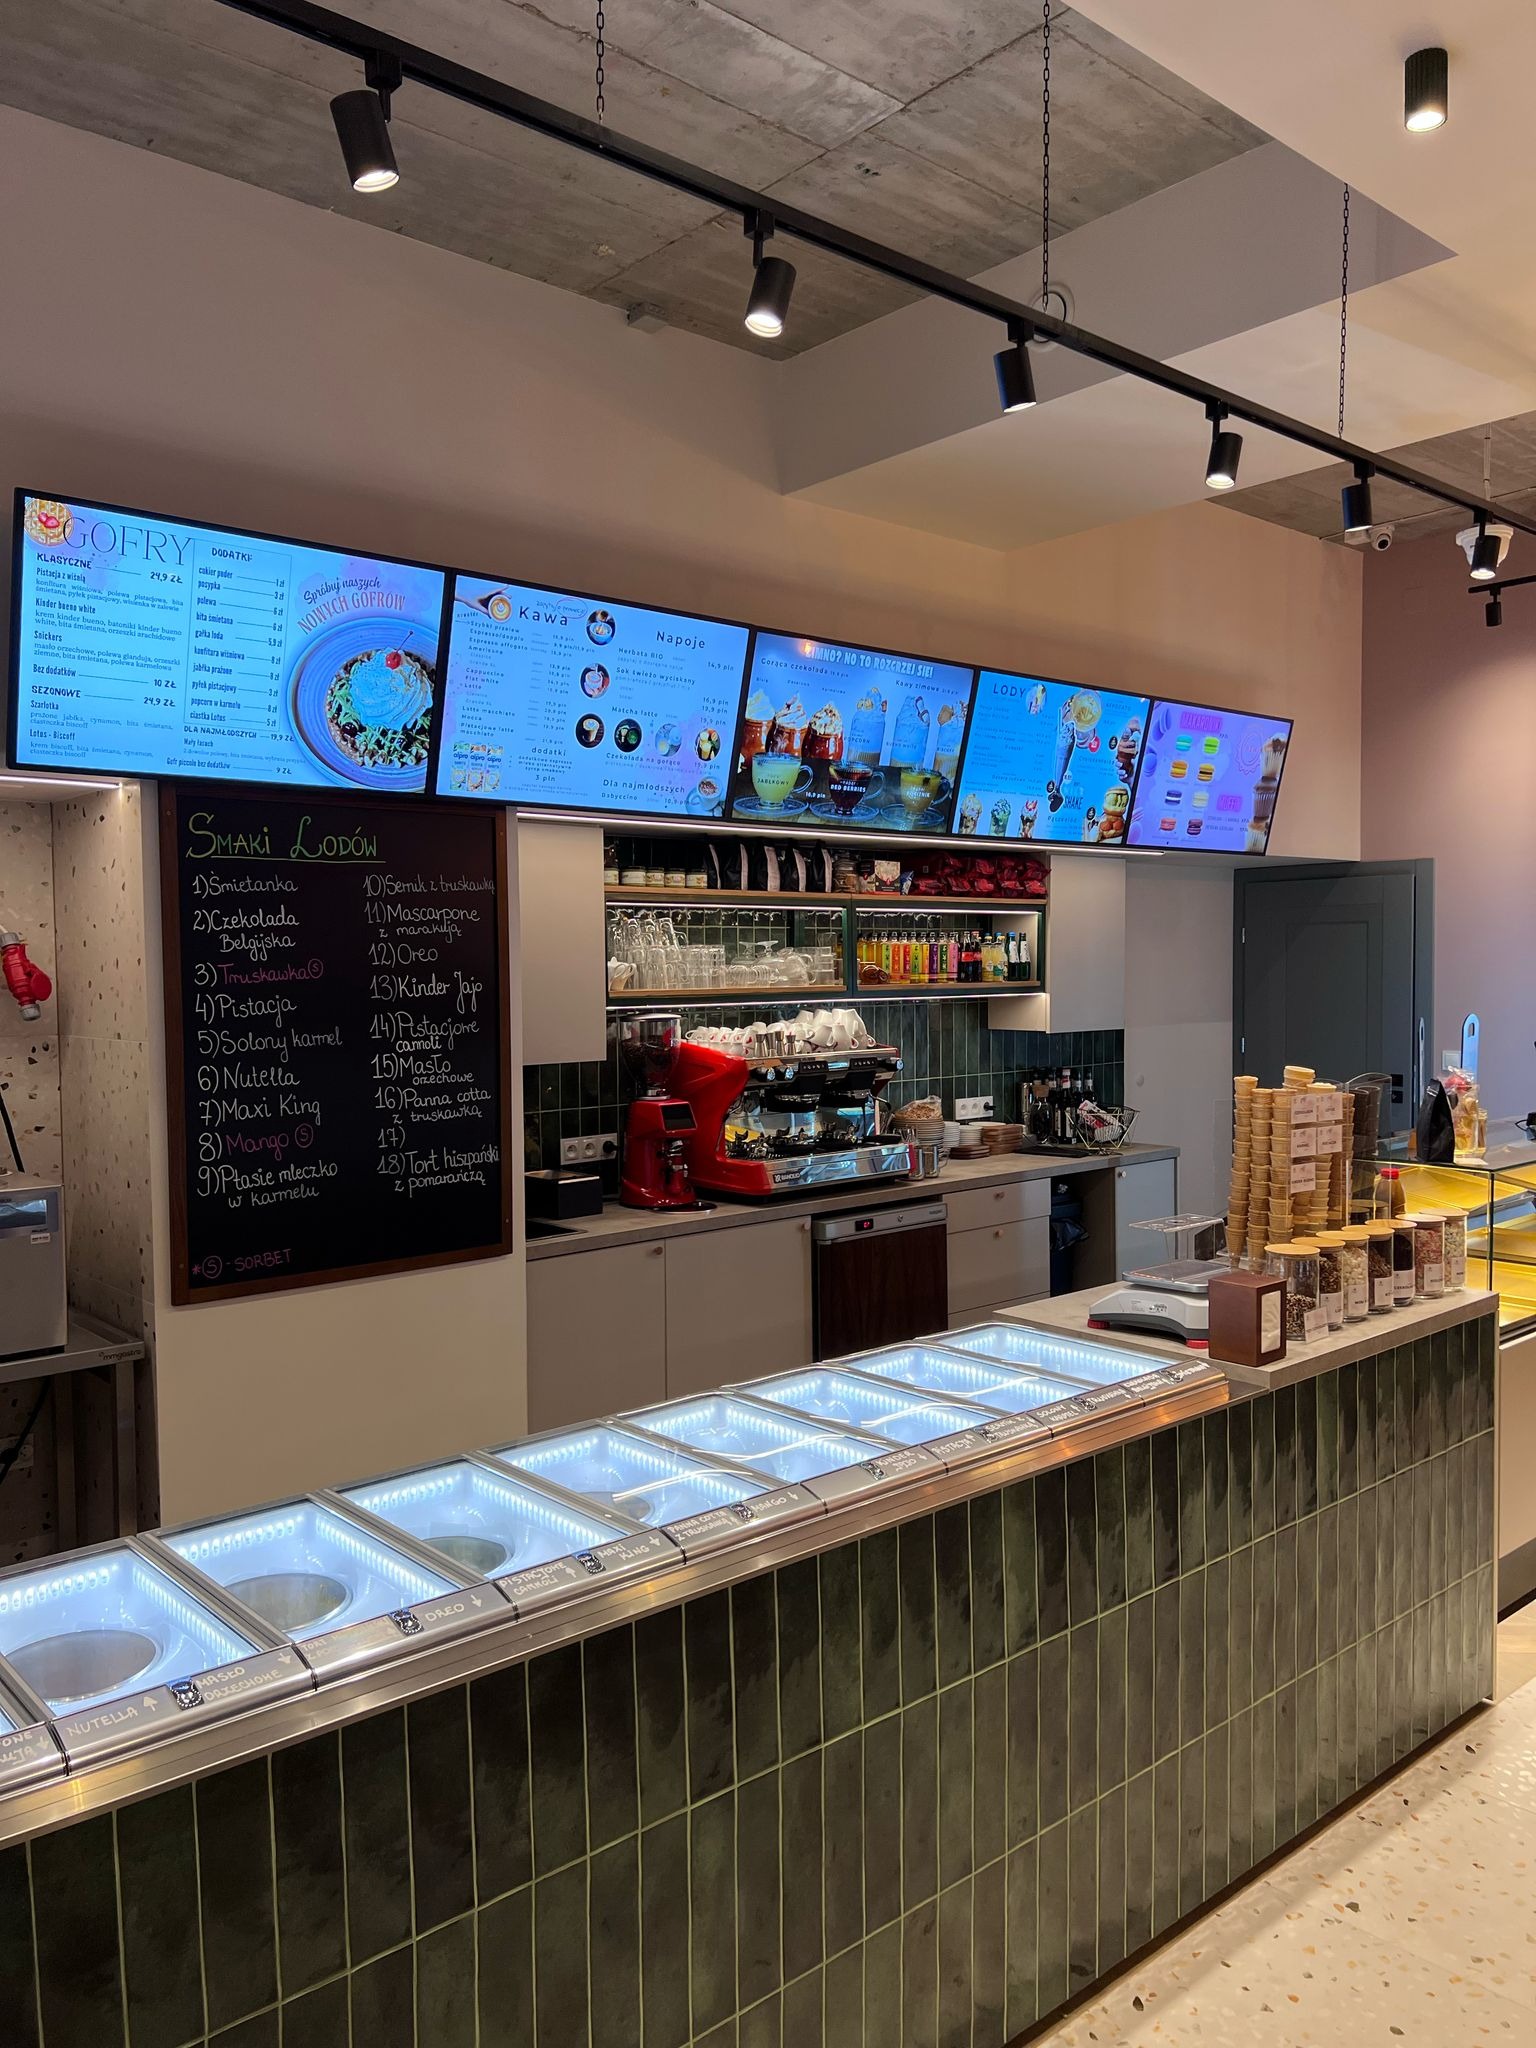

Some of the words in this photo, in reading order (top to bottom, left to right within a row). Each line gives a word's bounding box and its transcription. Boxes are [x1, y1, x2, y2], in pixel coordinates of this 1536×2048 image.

[63, 517, 191, 566] GOFRY
[37, 552, 93, 570] KLASYCZNE
[212, 548, 252, 562] DODATKI:
[37, 567, 61, 580] Pistacja
[151, 571, 169, 584] 24,9
[170, 573, 183, 584] ZŁ
[198, 566, 216, 576] cukier
[217, 570, 232, 579] puder
[198, 580, 221, 591] posypka
[303, 577, 340, 605] Spróbuj
[342, 577, 381, 592] naszych
[36, 598, 57, 609] Kinder
[58, 601, 78, 612] bueno
[79, 604, 96, 615] white
[197, 596, 216, 606] polewa
[297, 595, 349, 635] NOWYCH
[519, 606, 568, 626] Kawa
[34, 630, 63, 642] Snickers
[656, 630, 705, 649] Napoje
[618, 647, 648, 658] Herbata
[650, 651, 664, 661] BIO
[844, 652, 857, 666] NO
[859, 654, 872, 668] TO
[33, 663, 45, 673] Bez
[616, 667, 629, 675] Sok
[31, 685, 81, 698] SEZONOWE
[154, 679, 162, 687] 10
[164, 680, 176, 688] ZŁ
[993, 683, 1027, 698] LODY
[30, 700, 59, 710] Szarlotka
[144, 697, 161, 707] 24,9
[163, 698, 176, 707] ZŁ
[612, 705, 638, 716] Matcha
[30, 729, 47, 739] Lotus
[53, 730, 75, 741] Biscoff
[184, 725, 198, 734] DLA
[200, 727, 257, 739] NAJMŁODSZYCH
[531, 747, 566, 757] dodatki
[606, 752, 643, 763] Czekolada
[603, 779, 618, 788] Dla
[622, 781, 685, 795] najmłodszych
[430, 880, 437, 891] z
[387, 902, 480, 928] Mascarpone
[379, 928, 388, 938] z
[396, 920, 462, 944] marakują
[219, 932, 296, 962] Belgijska
[397, 943, 439, 965] Oreo
[217, 962, 308, 985] Truskawka
[398, 972, 450, 998] Kinder
[453, 970, 483, 1014] Jajo
[215, 993, 297, 1028] Pistacja
[291, 1026, 343, 1048] karmel
[395, 1035, 442, 1053] cannoli
[223, 1061, 301, 1090] Nutella
[412, 1071, 474, 1085] orzechowe
[402, 1087, 453, 1109] Panna
[457, 1087, 491, 1103] cotta
[222, 1096, 272, 1123] Maxi
[279, 1094, 321, 1126] King
[392, 1113, 402, 1124] z
[410, 1104, 483, 1122] truskawką
[377, 1125, 406, 1149] 17)
[226, 1131, 289, 1162] Mango
[404, 1148, 440, 1174] Tort
[443, 1143, 499, 1170] hiszpański
[219, 1164, 274, 1194] Ptasie
[279, 1159, 338, 1182] mleczko
[394, 1179, 404, 1192] z
[408, 1169, 487, 1199] pomarańczą
[228, 1194, 242, 1209] w
[251, 1183, 320, 1207] karmelu
[234, 1248, 292, 1273] SORBET
[424, 1602, 465, 1623] OREO
[198, 1666, 246, 1689] MASŁO
[66, 1705, 139, 1738] NUTELLA
